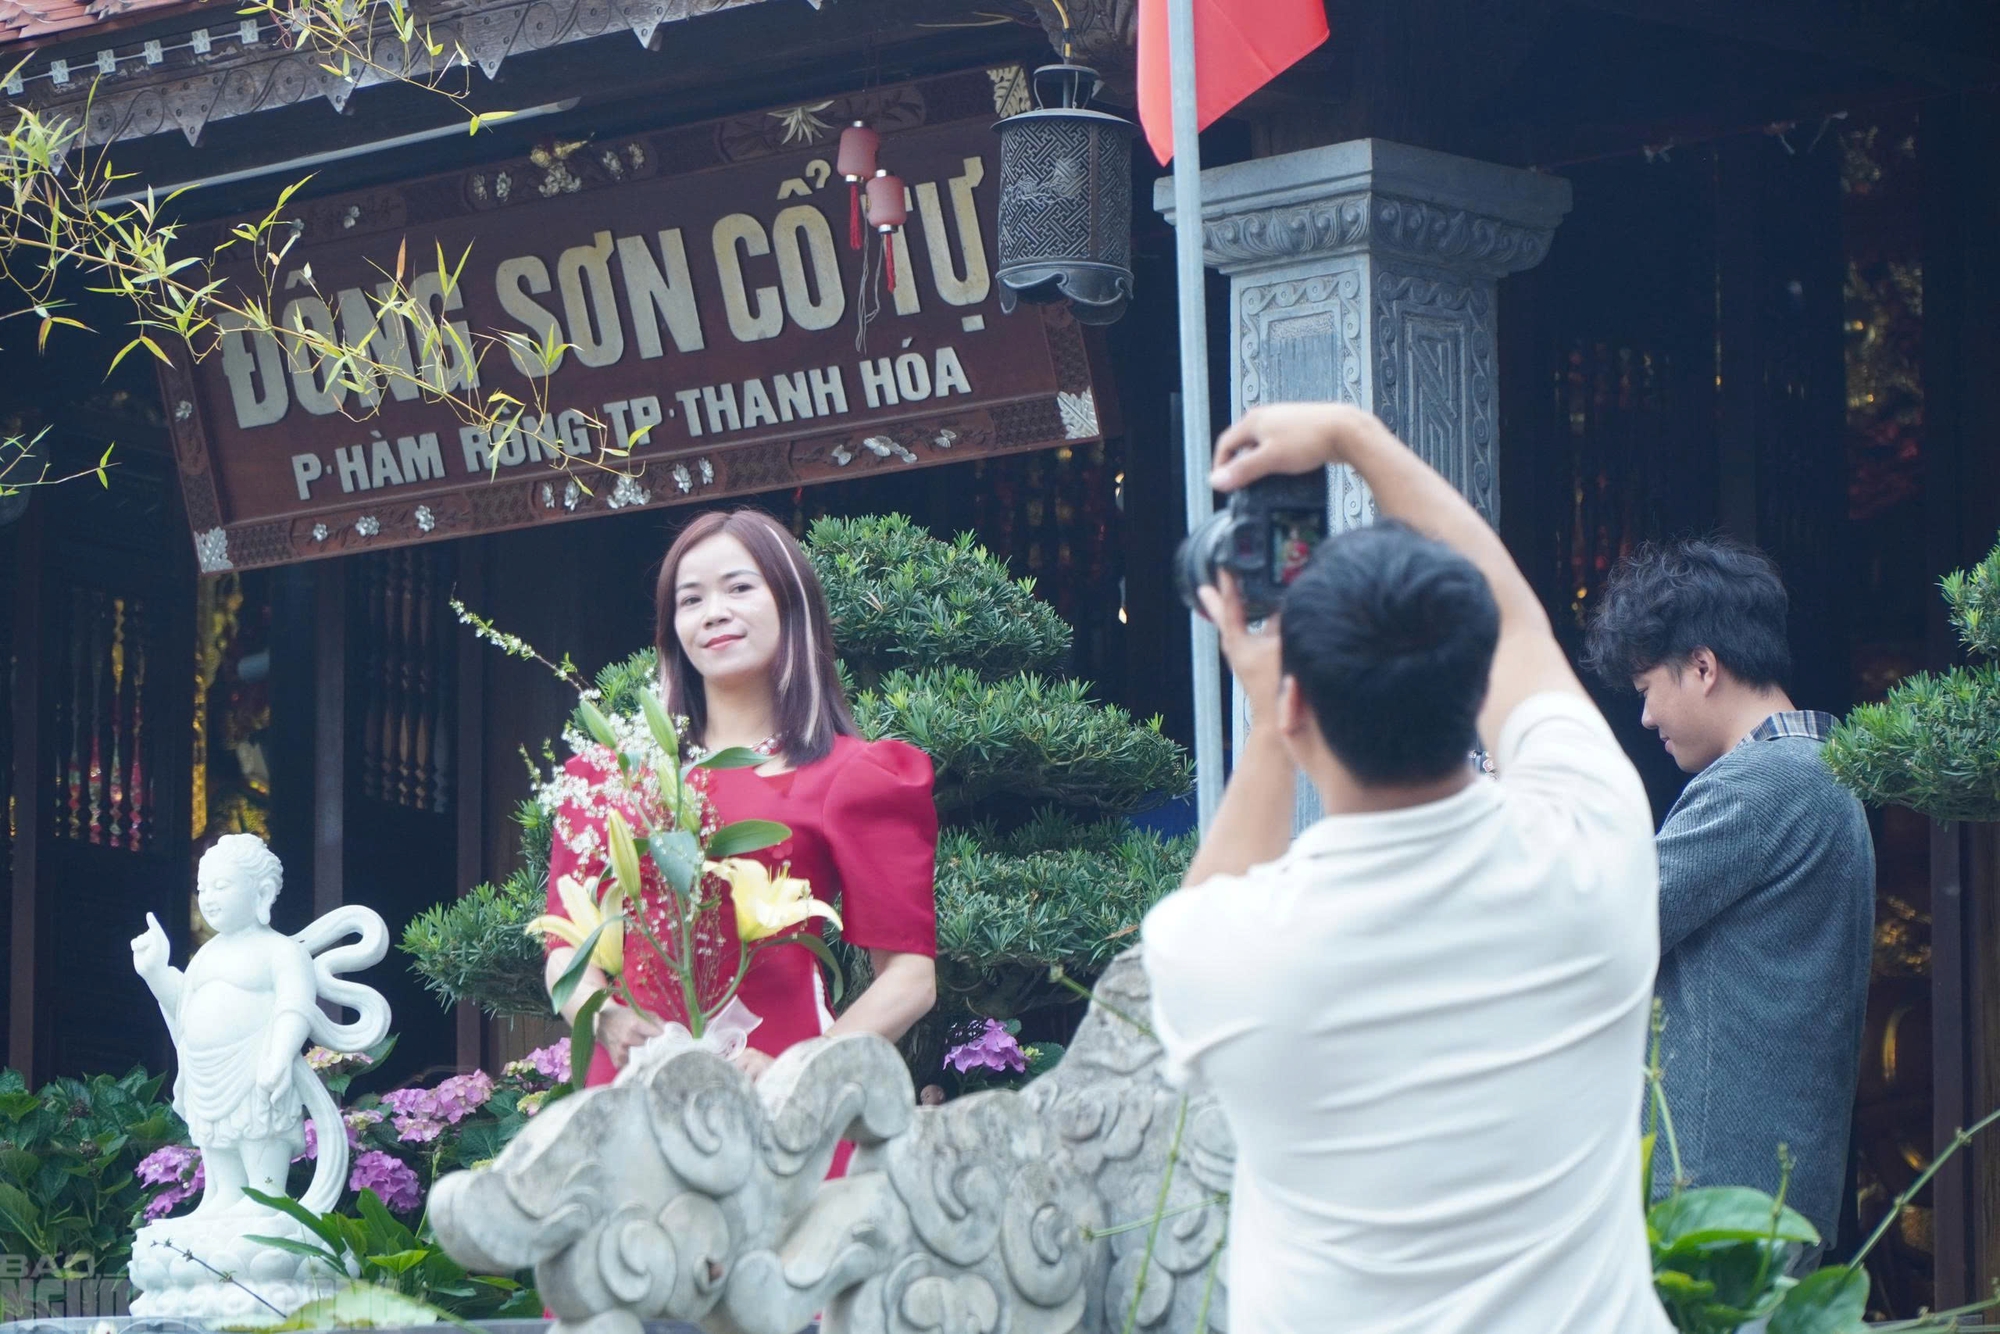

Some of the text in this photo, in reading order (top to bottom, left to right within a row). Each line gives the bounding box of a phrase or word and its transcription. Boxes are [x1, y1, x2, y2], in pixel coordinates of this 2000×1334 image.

[216, 269, 480, 429] ĐÔNG
[496, 229, 705, 378] SƠN
[712, 159, 845, 342] CỔ
[859, 337, 972, 408] HÓA
